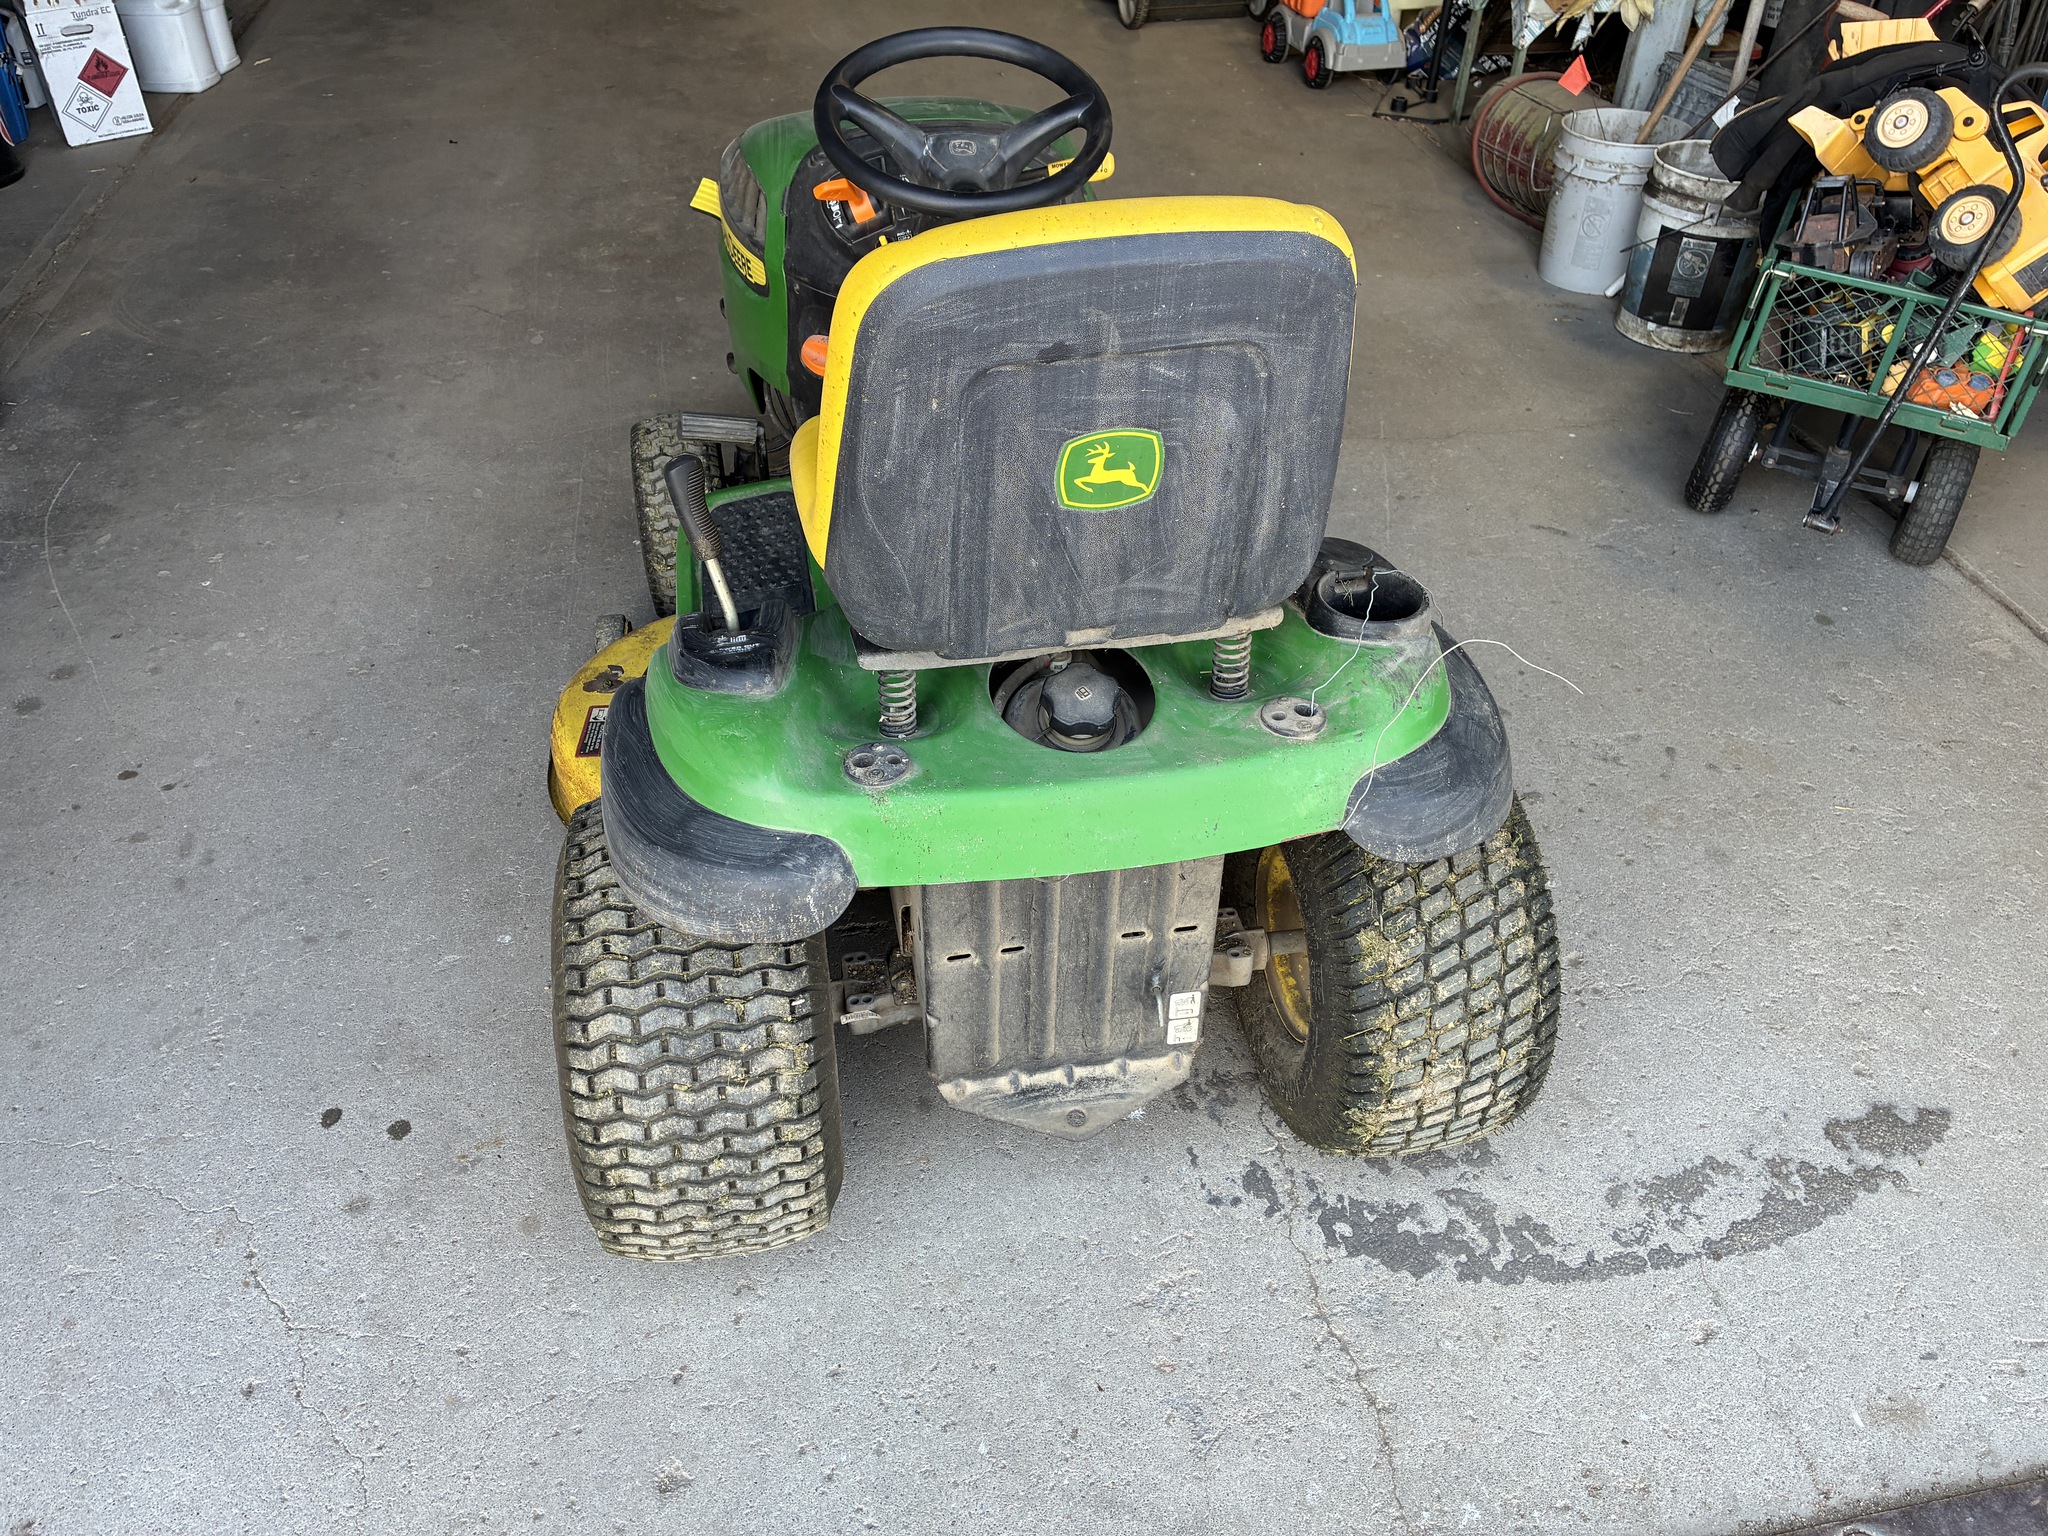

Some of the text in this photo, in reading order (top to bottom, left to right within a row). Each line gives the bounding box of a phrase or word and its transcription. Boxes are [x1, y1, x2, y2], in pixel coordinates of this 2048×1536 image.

[70, 8, 99, 19] Tundra
[100, 6, 111, 14] EC
[76, 104, 100, 114] TOXIC
[1051, 161, 1070, 169] MOWE
